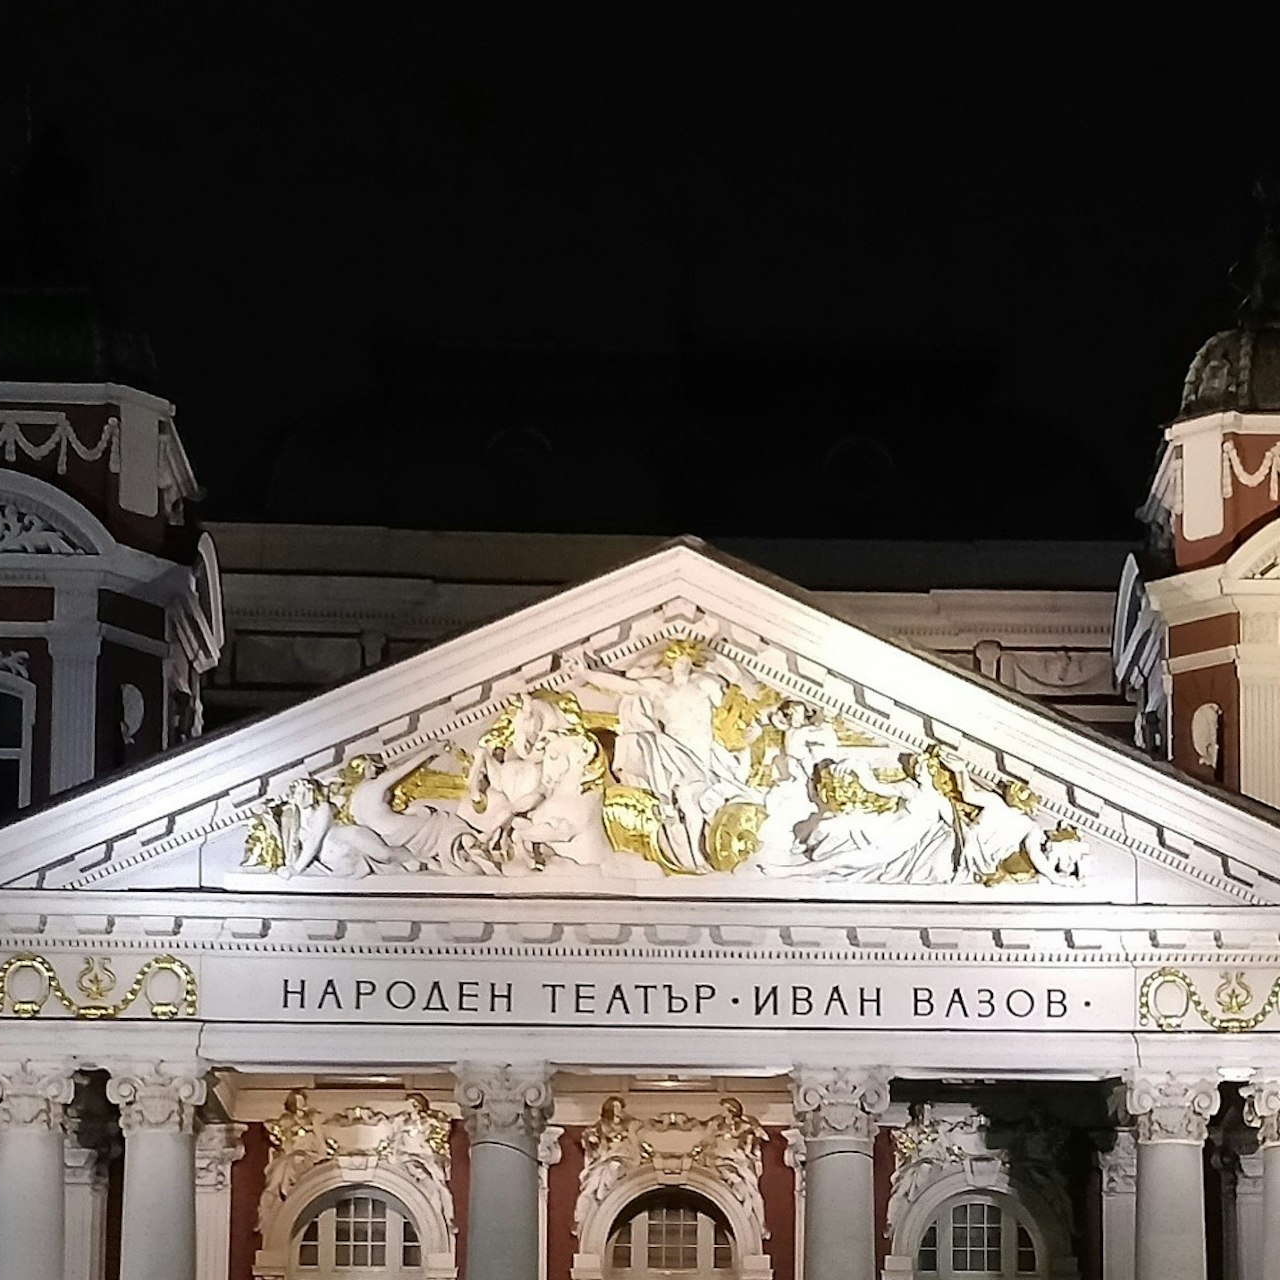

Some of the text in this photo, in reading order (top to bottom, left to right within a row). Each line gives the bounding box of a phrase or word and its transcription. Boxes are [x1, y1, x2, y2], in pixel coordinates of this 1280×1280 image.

[282, 978, 1068, 1019] НАРОДЕН ТЕАТЪР ИВАН ВАЗОВ
